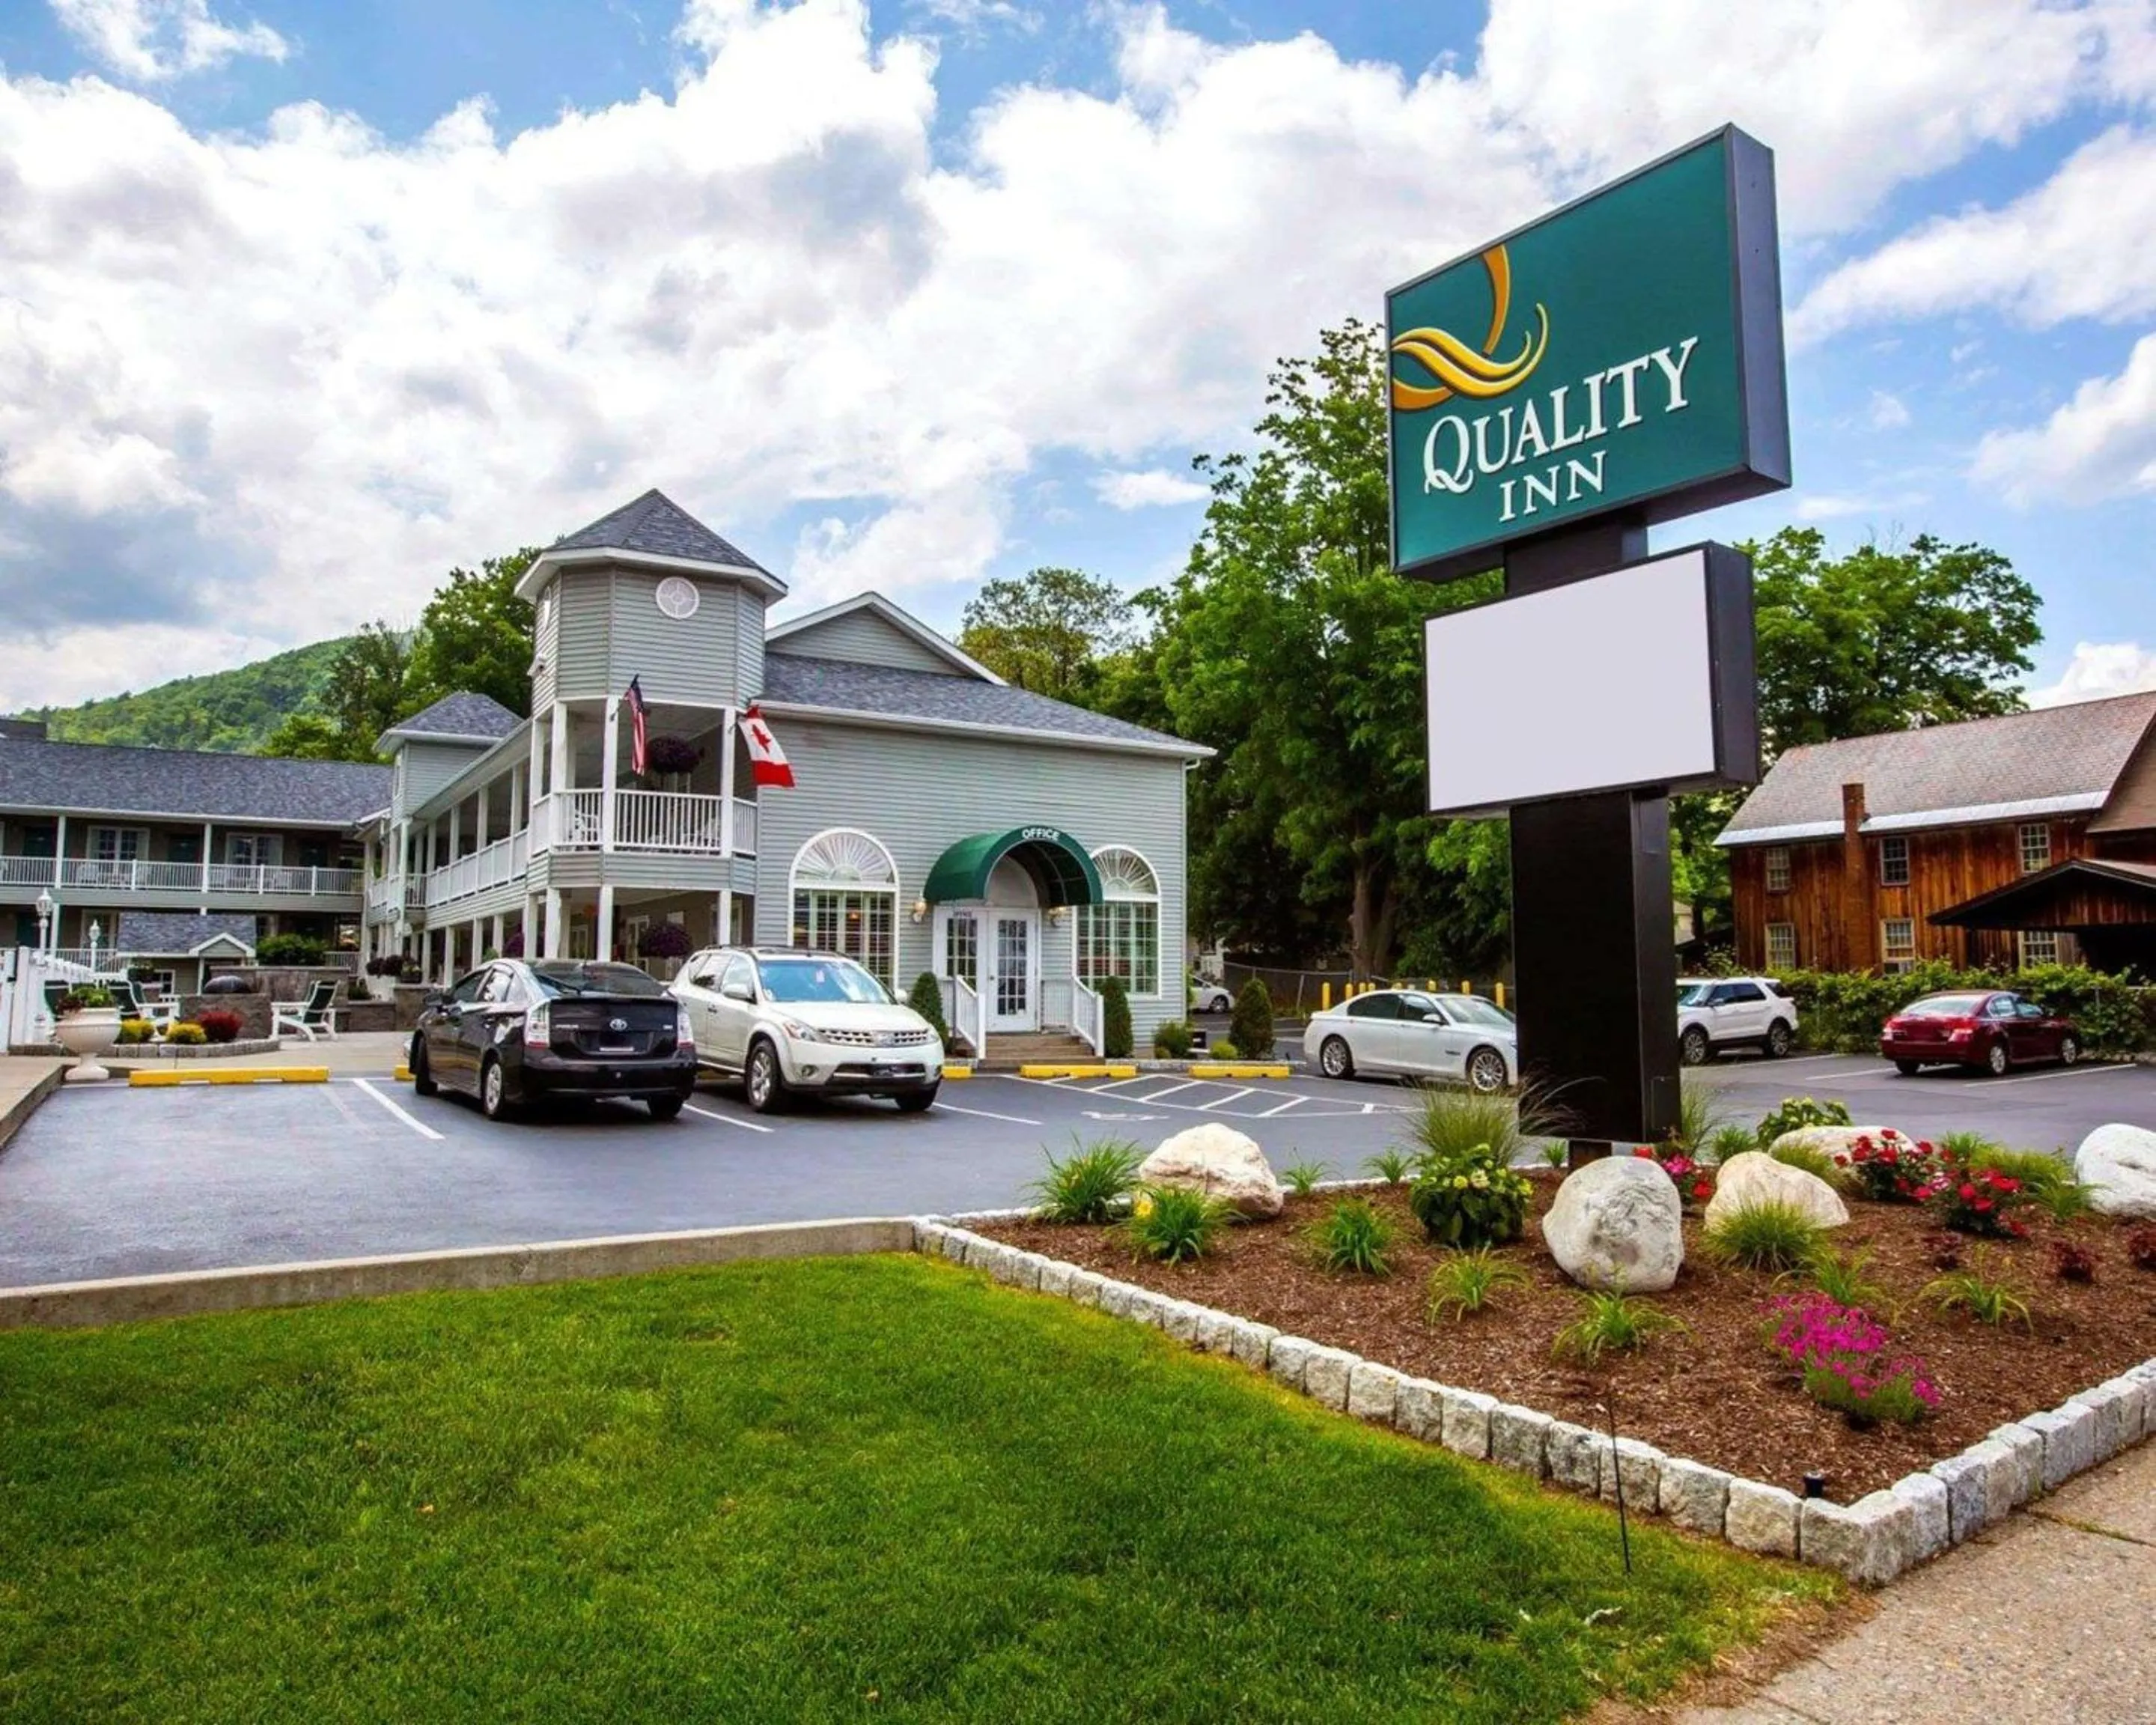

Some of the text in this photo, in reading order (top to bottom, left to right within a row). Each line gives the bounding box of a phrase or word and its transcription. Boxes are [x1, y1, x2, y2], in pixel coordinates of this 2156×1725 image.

[1424, 335, 1698, 494] QUALITY
[1499, 451, 1607, 523] INN
[1022, 827, 1060, 841] OFFICE
